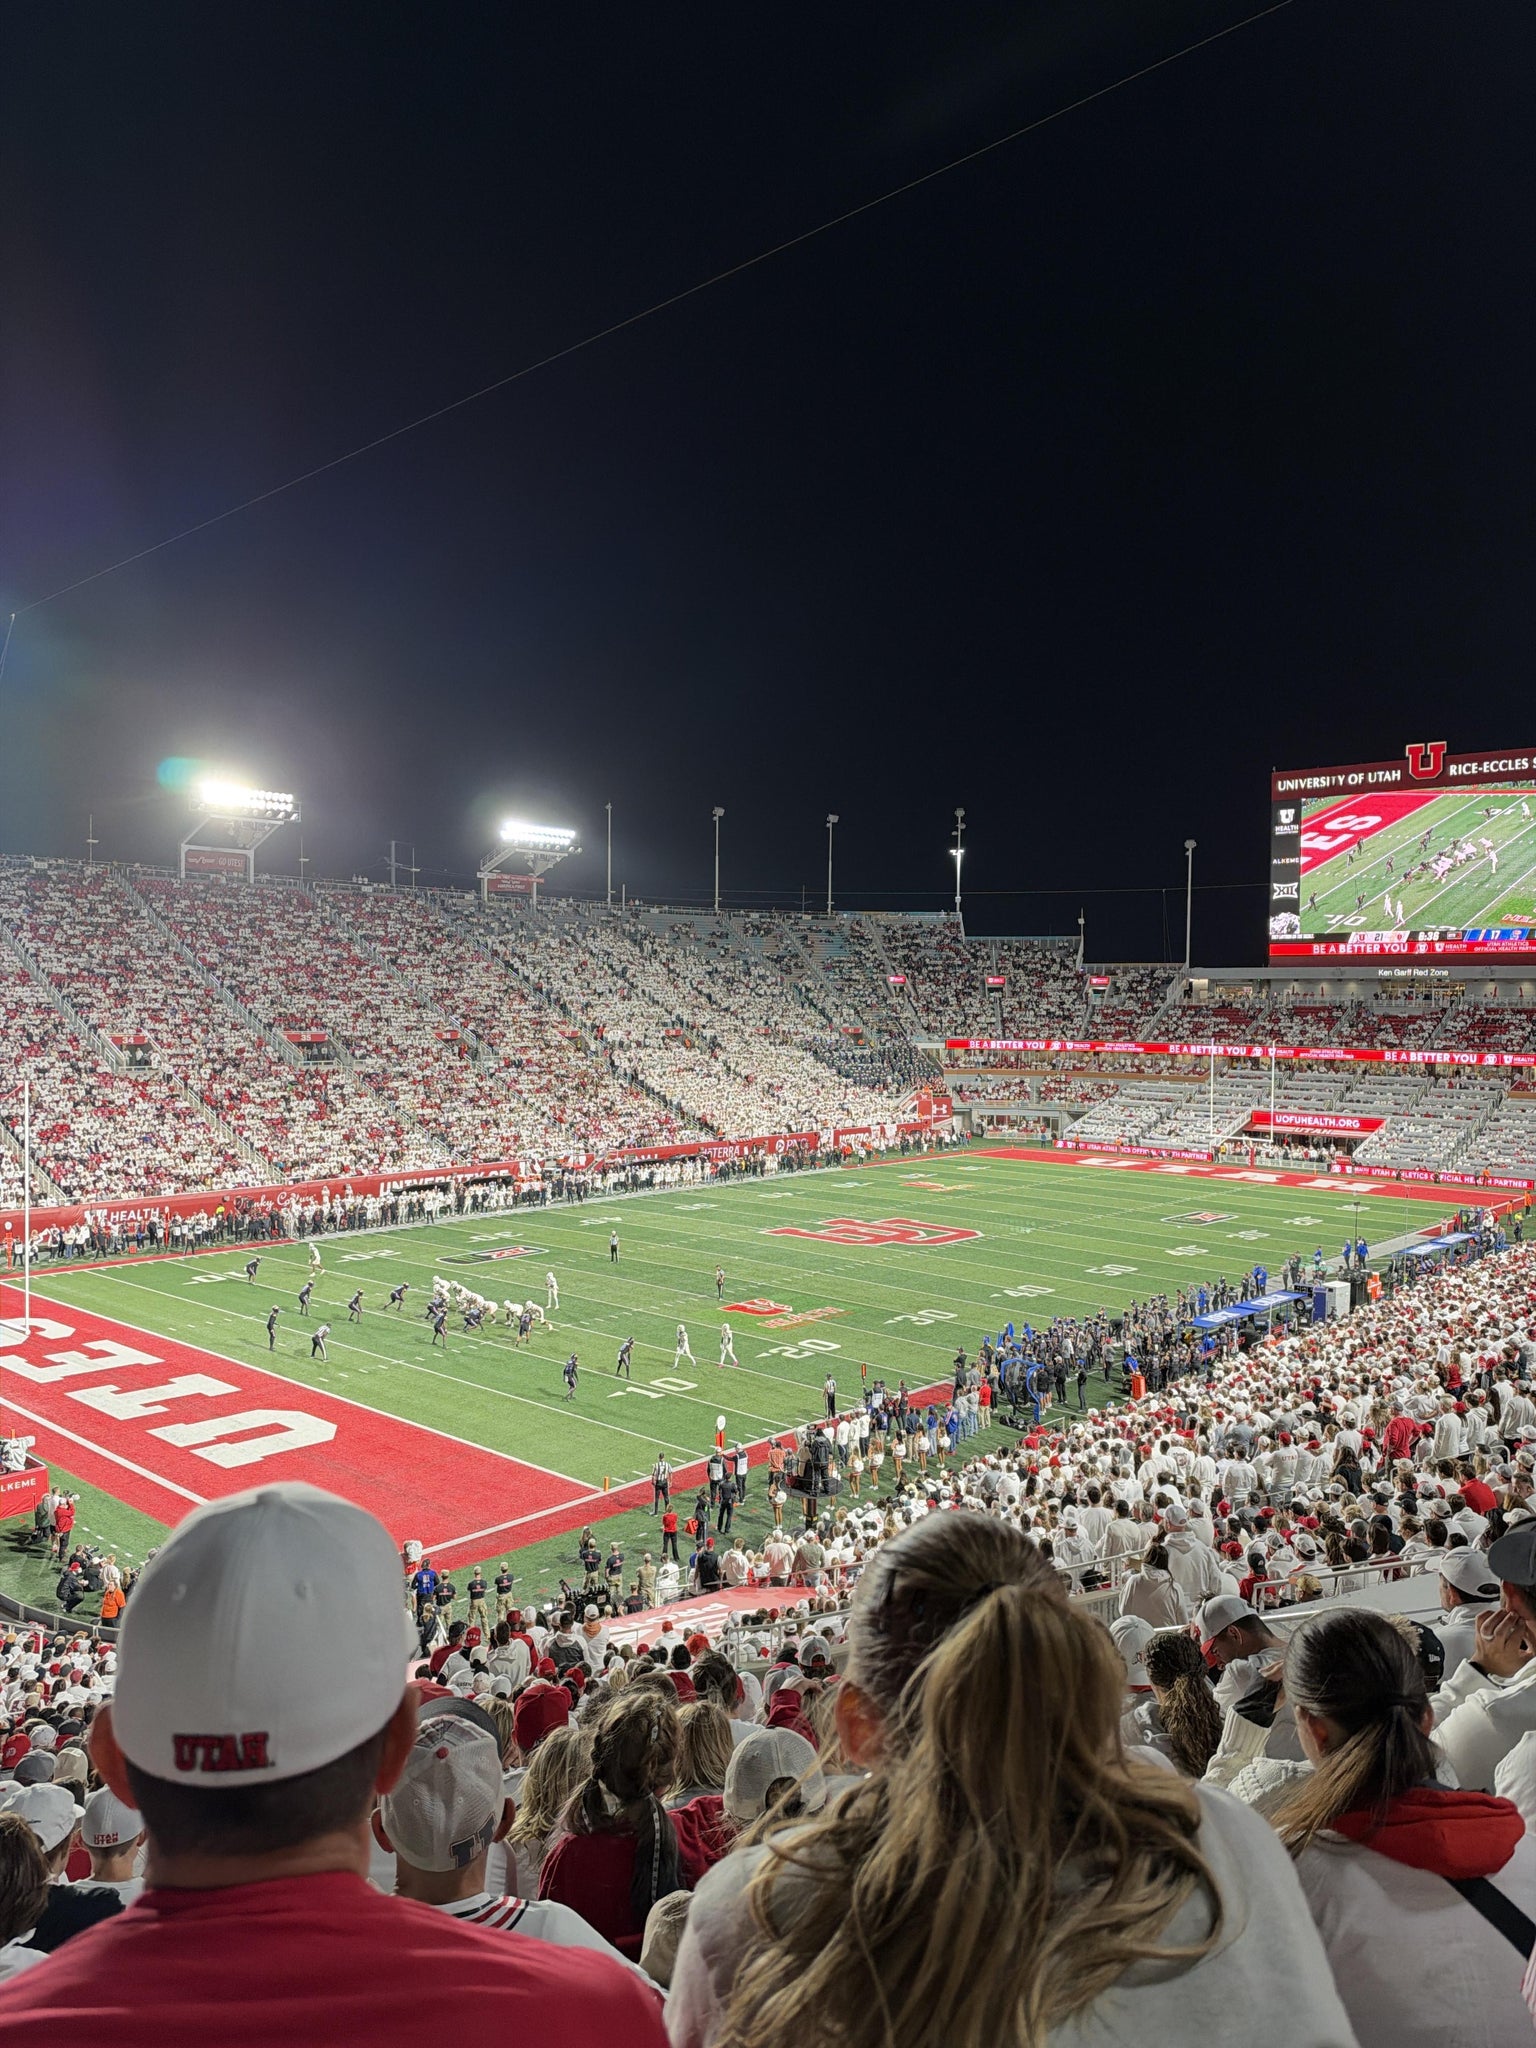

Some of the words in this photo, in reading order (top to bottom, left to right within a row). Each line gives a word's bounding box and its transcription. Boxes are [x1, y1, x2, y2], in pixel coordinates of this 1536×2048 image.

[1406, 741, 1447, 780] U
[1449, 757, 1529, 776] RICE-ECCLES
[1277, 774, 1345, 791] UNIVERSITY
[1348, 772, 1364, 785] OF
[1368, 769, 1401, 783] UTAH
[1275, 824, 1299, 832] HEALTH
[1313, 944, 1327, 953] BE
[1328, 943, 1337, 953] A
[1338, 942, 1380, 953] BETTER
[1382, 942, 1408, 952] YOU
[1378, 968, 1393, 976] Ken
[1393, 968, 1412, 977] Garff
[122, 1036, 134, 1044] 34
[300, 1034, 312, 1042] 35
[990, 1041, 1023, 1050] BETTER
[1025, 1041, 1045, 1049] YOU
[1169, 1045, 1180, 1053] BE
[1190, 1045, 1224, 1055] BETTER
[1226, 1047, 1247, 1055] YOU
[1385, 1051, 1397, 1060] BE
[1401, 1052, 1408, 1060] A
[1409, 1052, 1450, 1062] BETTER
[1452, 1053, 1477, 1063] YOU
[1275, 1114, 1360, 1128] UOFUHEALTH.ORG
[1371, 1168, 1390, 1177] UTAH
[1494, 1178, 1528, 1189] PARTNER
[110, 1207, 160, 1223] HEALTH
[1084, 1263, 1139, 1277] 50
[768, 1338, 842, 1359] 20
[625, 1377, 699, 1400] 10
[172, 1731, 270, 1773] UTAH
[94, 1832, 119, 1840] UTAH
